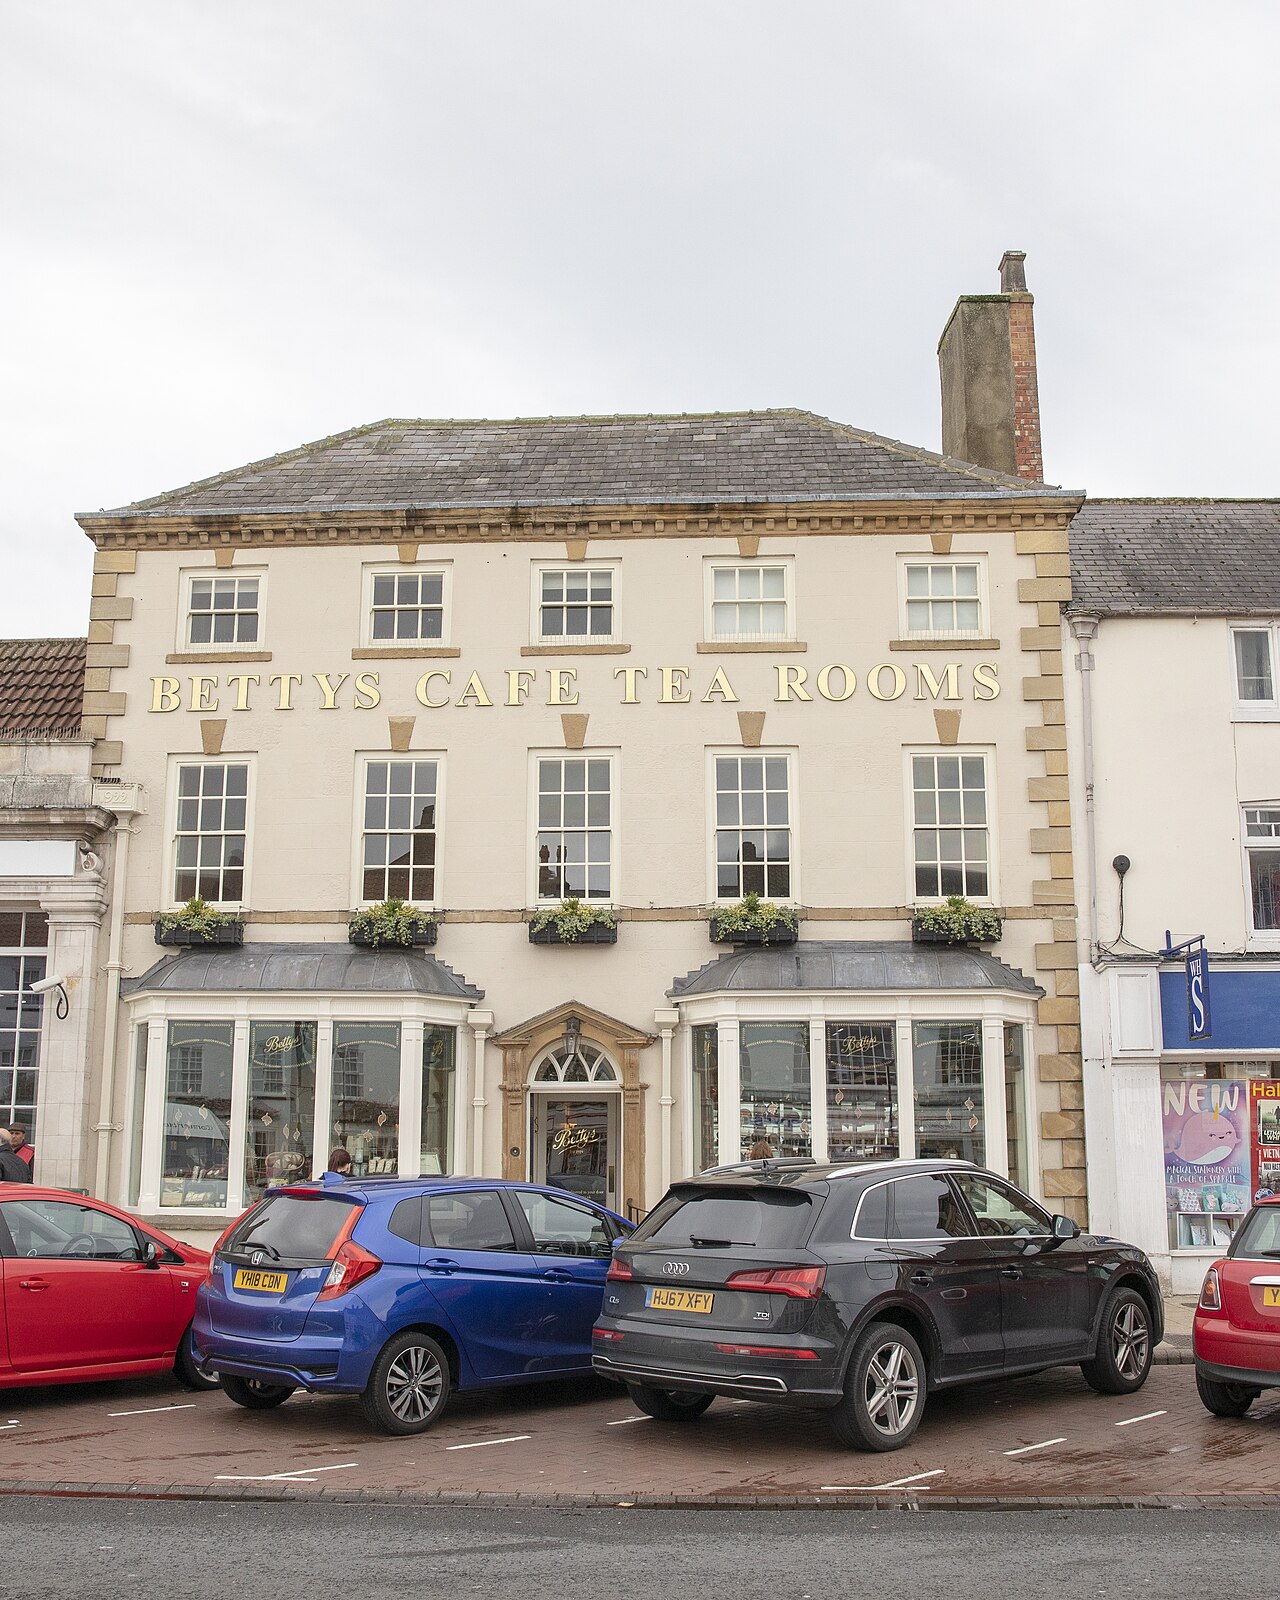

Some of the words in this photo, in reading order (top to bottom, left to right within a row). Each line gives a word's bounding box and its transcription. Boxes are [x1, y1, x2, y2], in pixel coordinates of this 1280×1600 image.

[147, 671, 381, 713] BETTYS
[415, 668, 580, 708] CAFE
[613, 664, 740, 704] TEA
[773, 662, 1001, 701] ROOMS
[264, 1034, 303, 1056] Bettys
[840, 1035, 880, 1056] Bettys
[1164, 1082, 1239, 1115] NEW
[552, 1128, 600, 1155] Bettys
[1166, 1165, 1192, 1174] MAGICAL
[240, 1271, 262, 1287] YH18
[261, 1274, 282, 1290] CDN
[653, 1290, 685, 1307] HJ67
[686, 1293, 711, 1310] XFY
